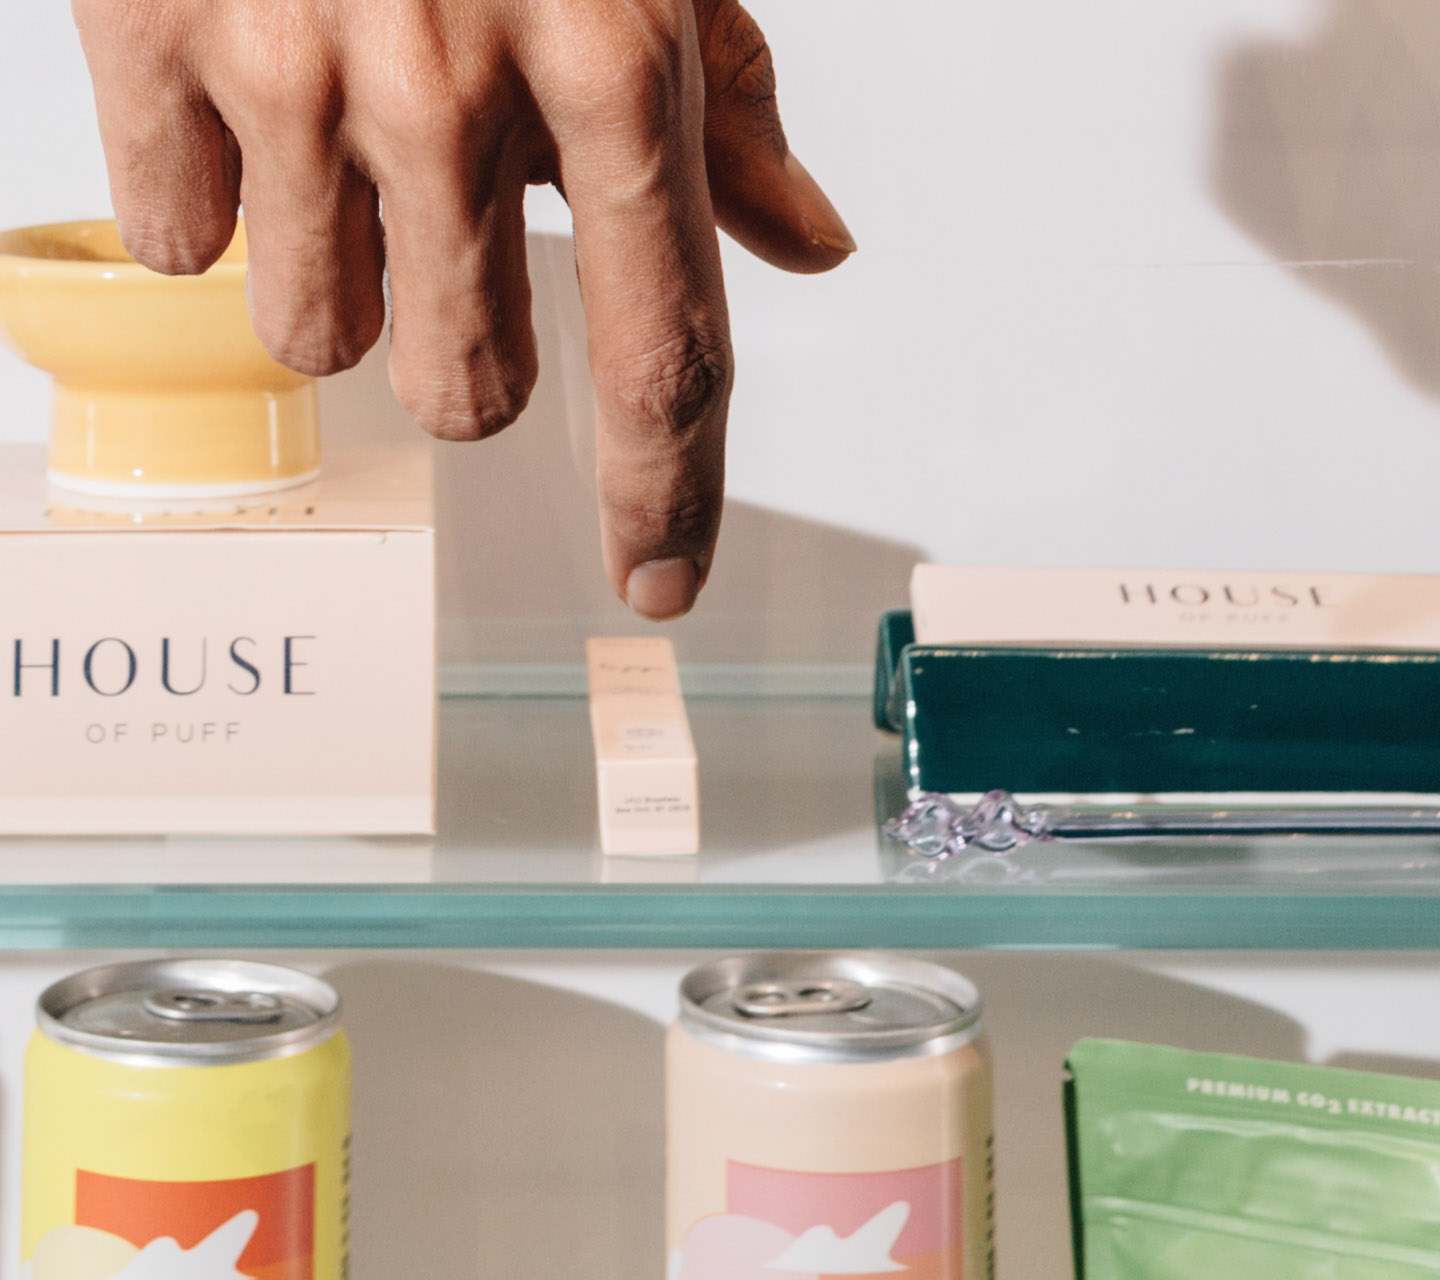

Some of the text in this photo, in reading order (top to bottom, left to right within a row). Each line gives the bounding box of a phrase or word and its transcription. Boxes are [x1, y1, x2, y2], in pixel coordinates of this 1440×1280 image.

[1118, 582, 1342, 608] HOUSE
[1225, 612, 1289, 624] PUFF
[12, 634, 318, 698] HOUSE
[84, 721, 244, 745] OF PUFF
[1185, 1076, 1291, 1106] PREMIUM
